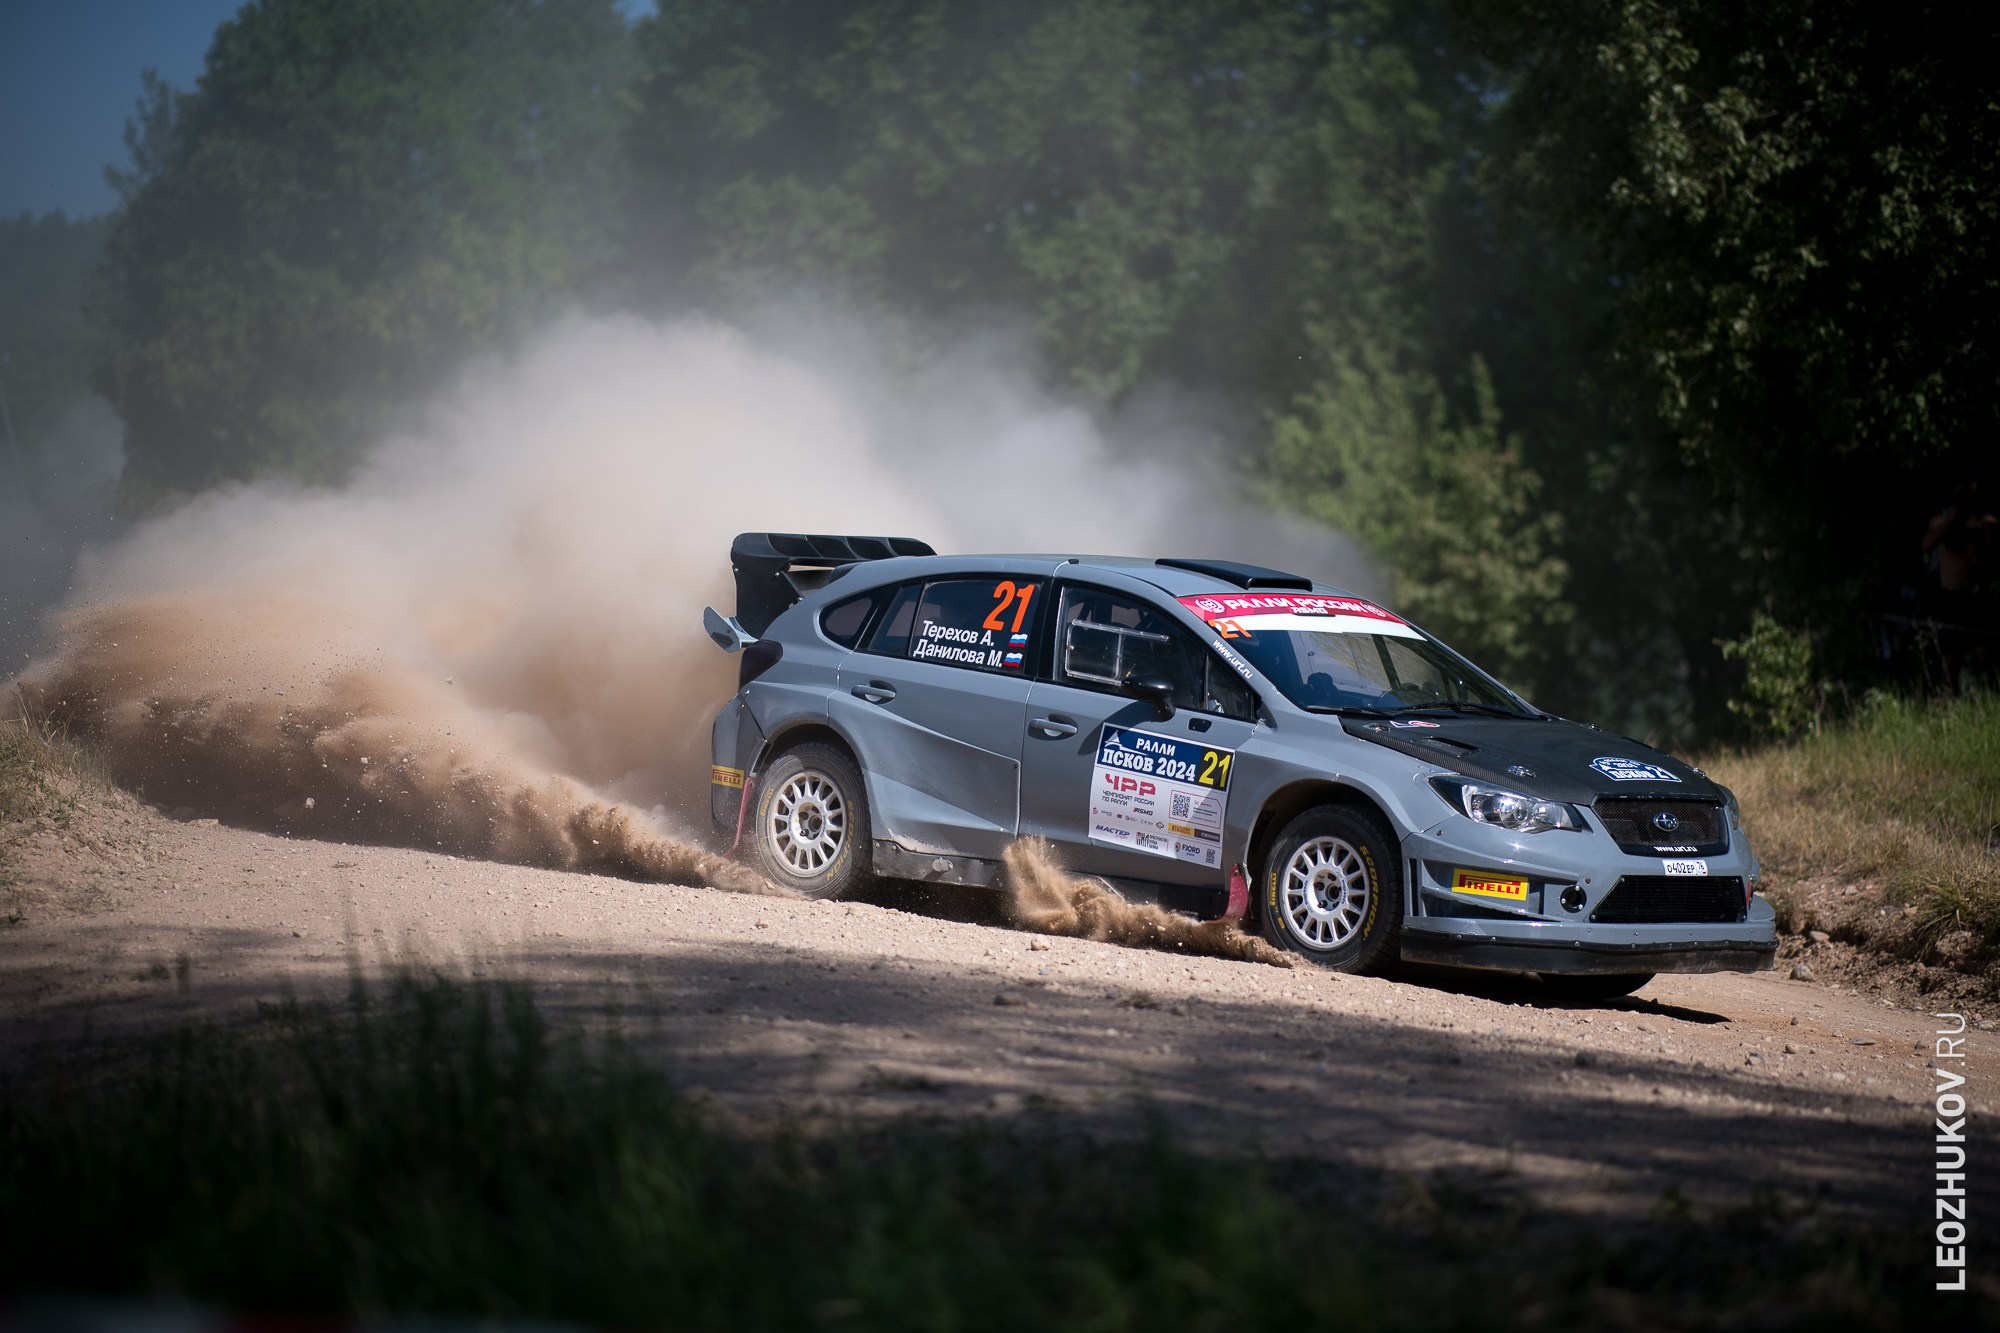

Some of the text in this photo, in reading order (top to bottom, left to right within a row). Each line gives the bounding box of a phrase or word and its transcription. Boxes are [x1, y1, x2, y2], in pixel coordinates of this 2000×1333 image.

[983, 581, 1035, 633] 21
[1223, 598, 1366, 612] РАЛЛИ РОССИИ
[922, 620, 995, 646] Терехов А.
[1208, 619, 1252, 638] 21
[913, 638, 1003, 667] Данилова М.
[1213, 640, 1253, 679] www.urt.ru
[1136, 738, 1176, 756] РАЛЛИ
[1102, 748, 1197, 781] ПСКОВ 2024
[1199, 751, 1231, 788] 21
[1105, 773, 1156, 796] ЧРР
[1102, 790, 1155, 806] ЧЕМПИОНАТ РОССИИ
[1110, 797, 1128, 806] РАЛЛИ
[1096, 824, 1131, 837] МАСТЕР
[1182, 844, 1201, 855] FJORD
[1360, 845, 1379, 937] SCORPION
[1459, 874, 1521, 895] PIRELLI
